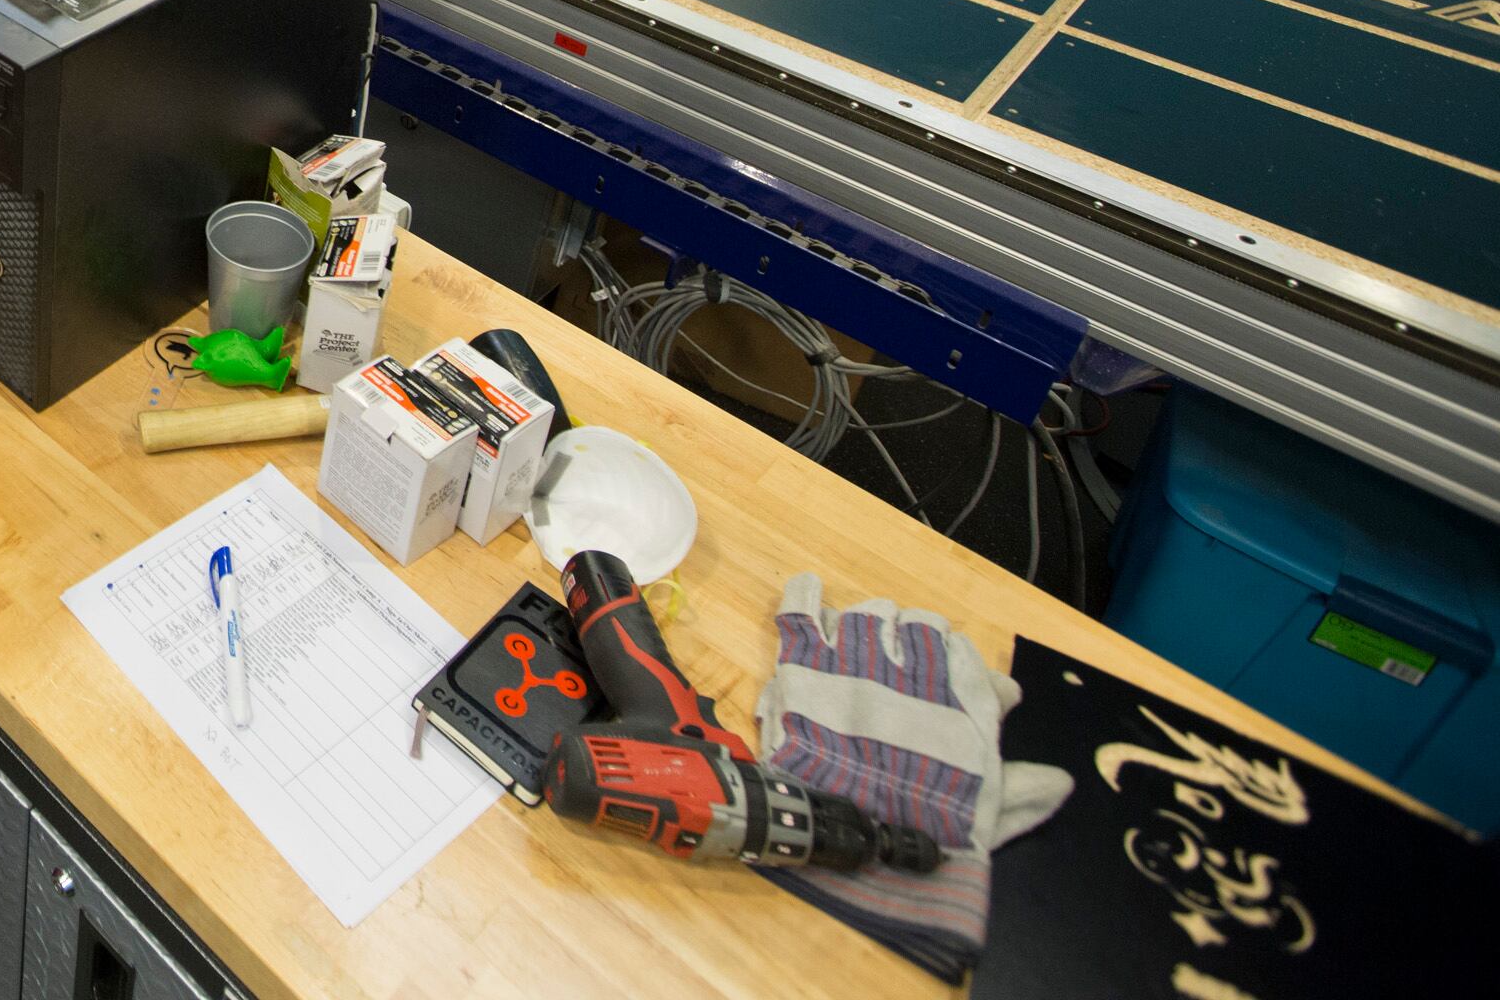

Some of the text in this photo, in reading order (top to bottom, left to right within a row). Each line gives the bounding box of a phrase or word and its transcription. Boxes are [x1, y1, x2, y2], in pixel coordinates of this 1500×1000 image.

[333, 332, 355, 341] THE
[319, 337, 360, 347] Project
[319, 343, 357, 353] Center
[431, 686, 540, 781] CAPACITOR
